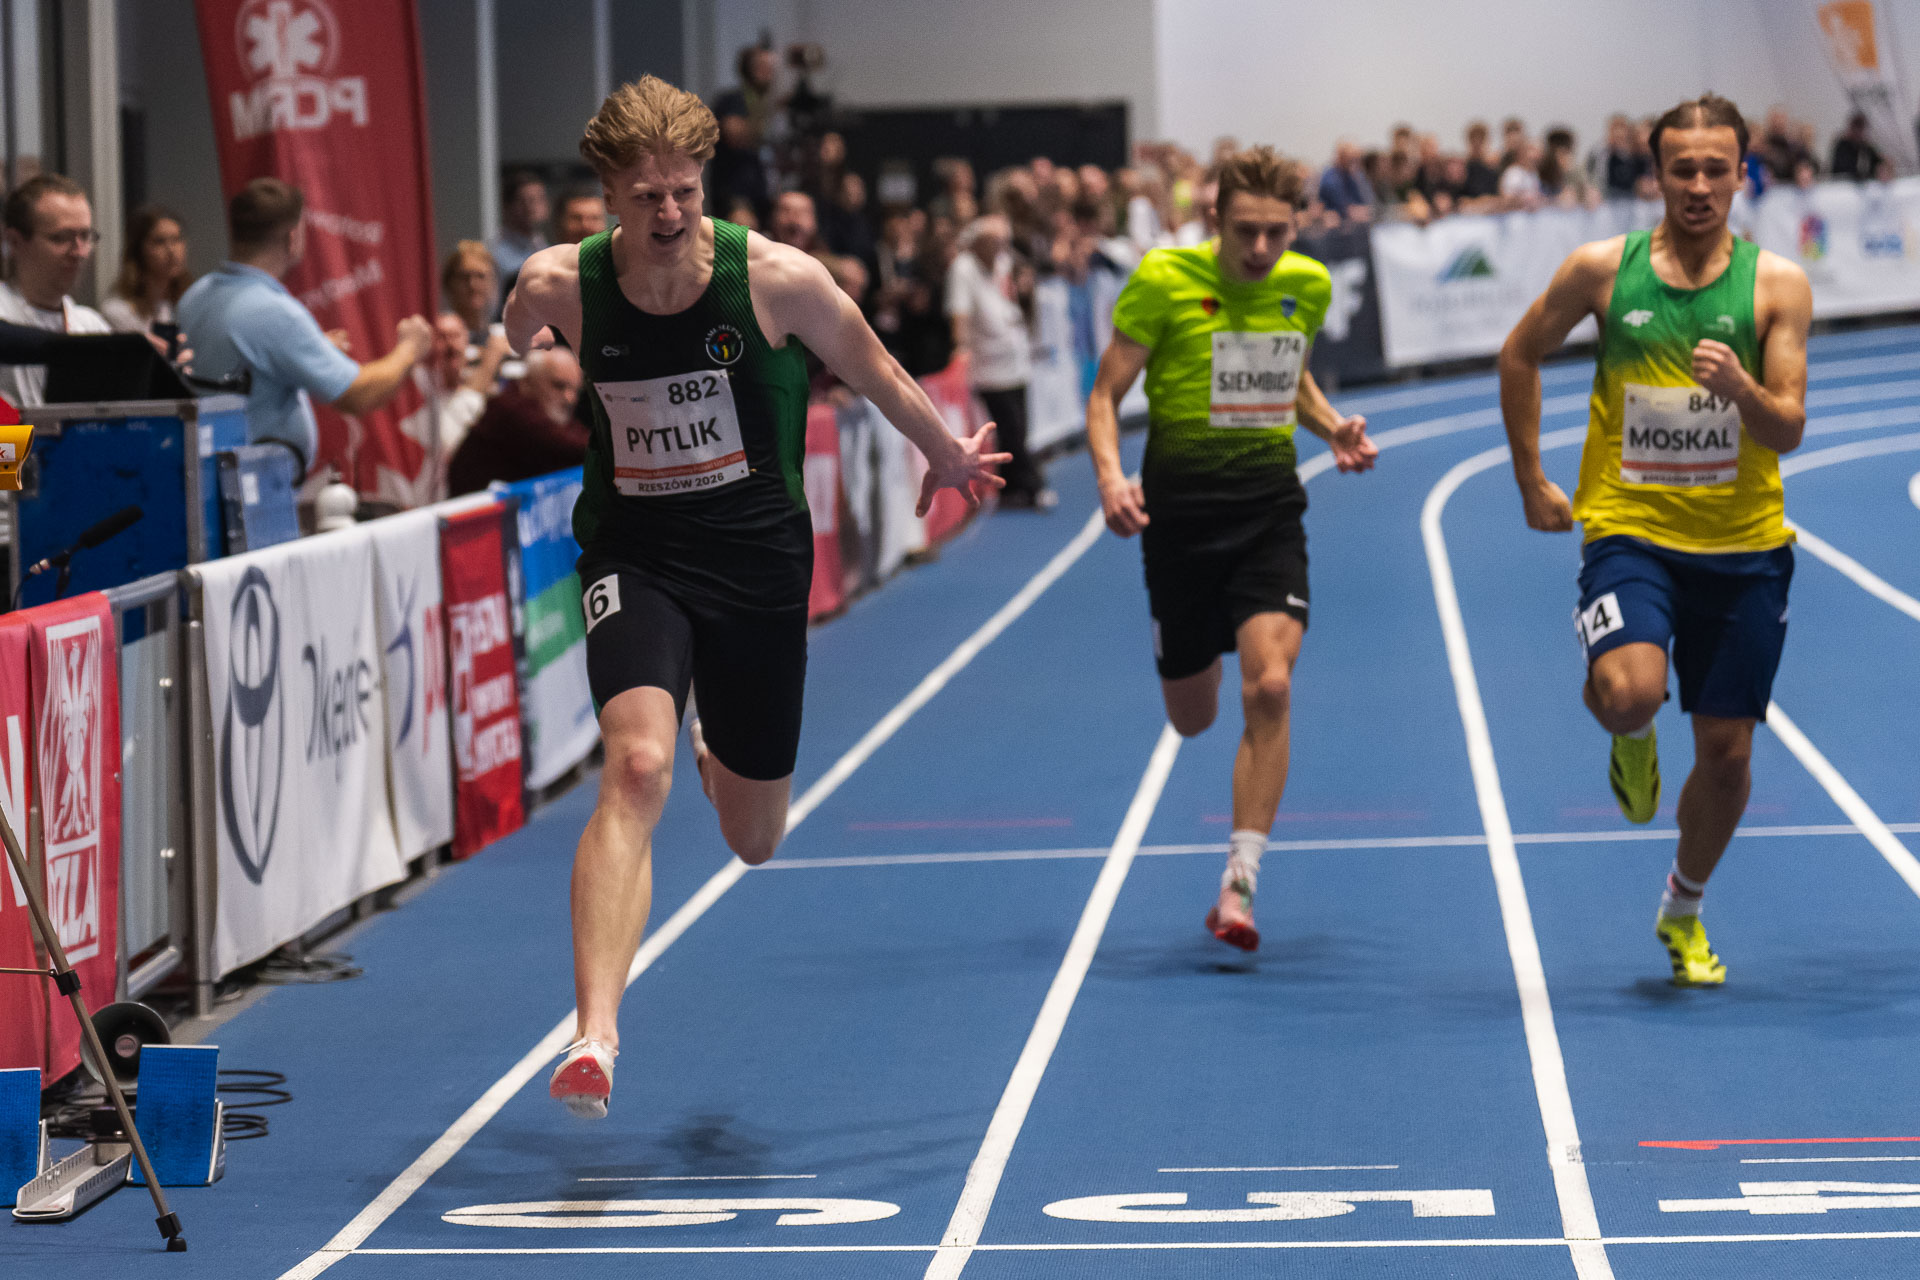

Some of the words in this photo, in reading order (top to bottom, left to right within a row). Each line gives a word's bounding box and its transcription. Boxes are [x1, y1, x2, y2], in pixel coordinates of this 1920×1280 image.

[667, 375, 720, 405] 882
[626, 416, 722, 454] PYTLIK
[1628, 426, 1735, 452] MOSKAL
[638, 479, 692, 492] RZESZÓW
[695, 471, 725, 486] 2026
[589, 583, 609, 621] 6
[1592, 602, 1612, 631] 4
[441, 1198, 901, 1228] 6
[1042, 1188, 1496, 1223] 5
